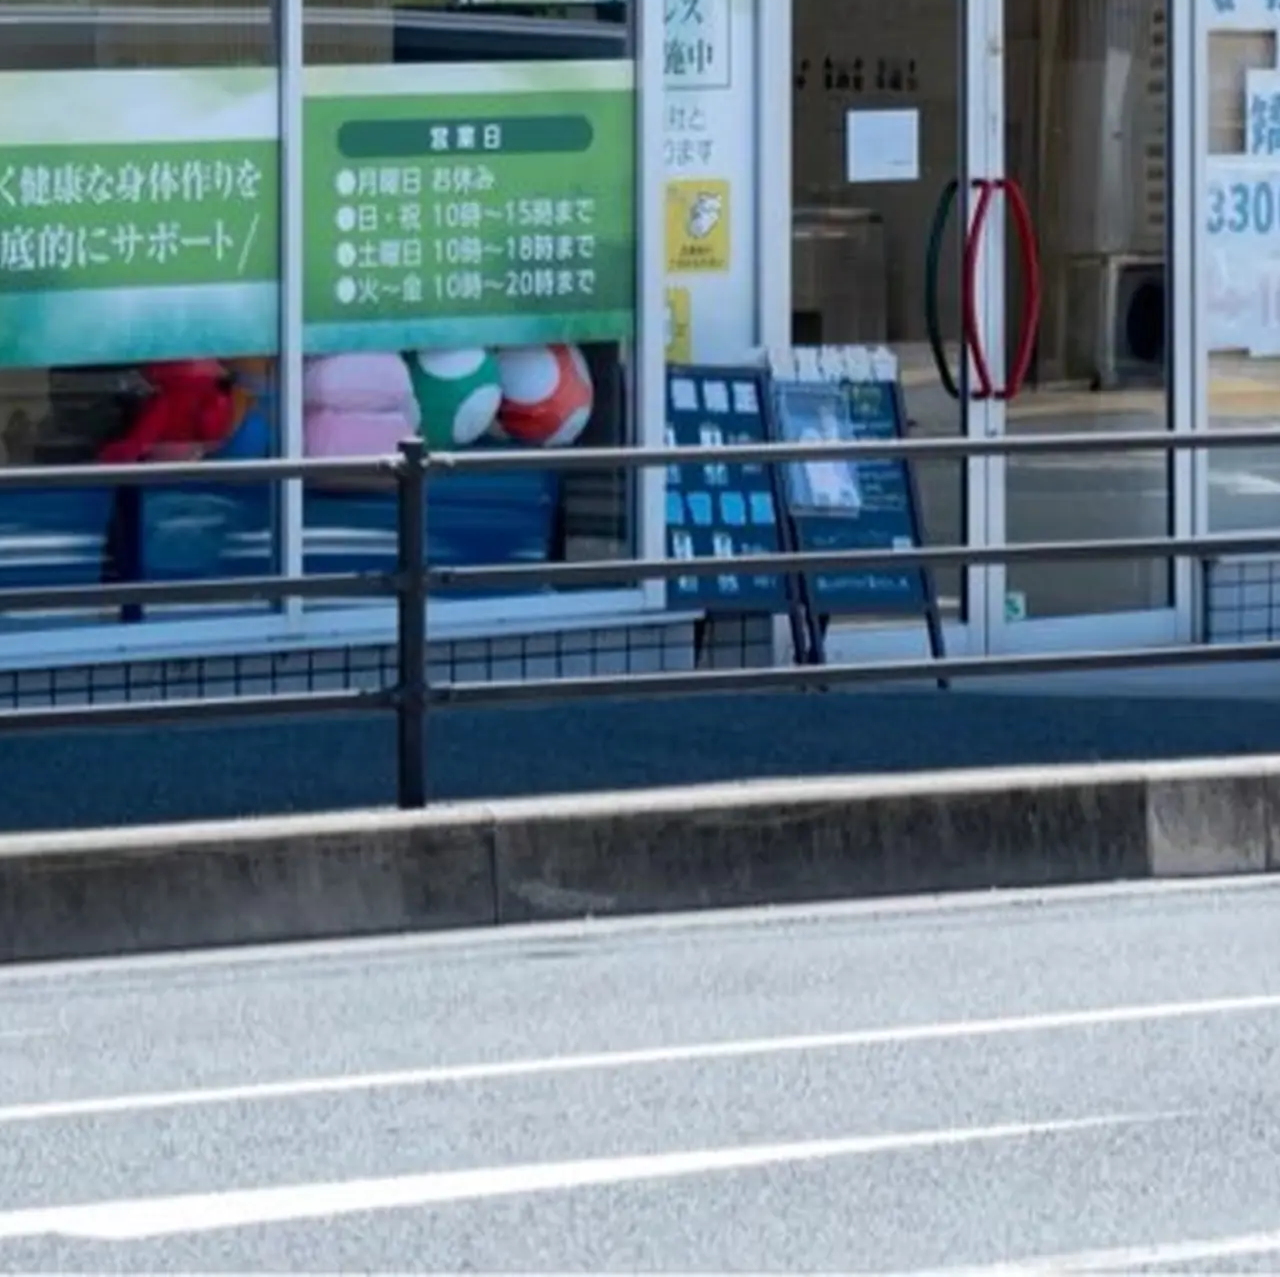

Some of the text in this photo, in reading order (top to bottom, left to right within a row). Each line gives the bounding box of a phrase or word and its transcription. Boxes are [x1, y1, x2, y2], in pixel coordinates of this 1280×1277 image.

[431, 124, 502, 151] 営業日
[433, 165, 495, 195] お休み
